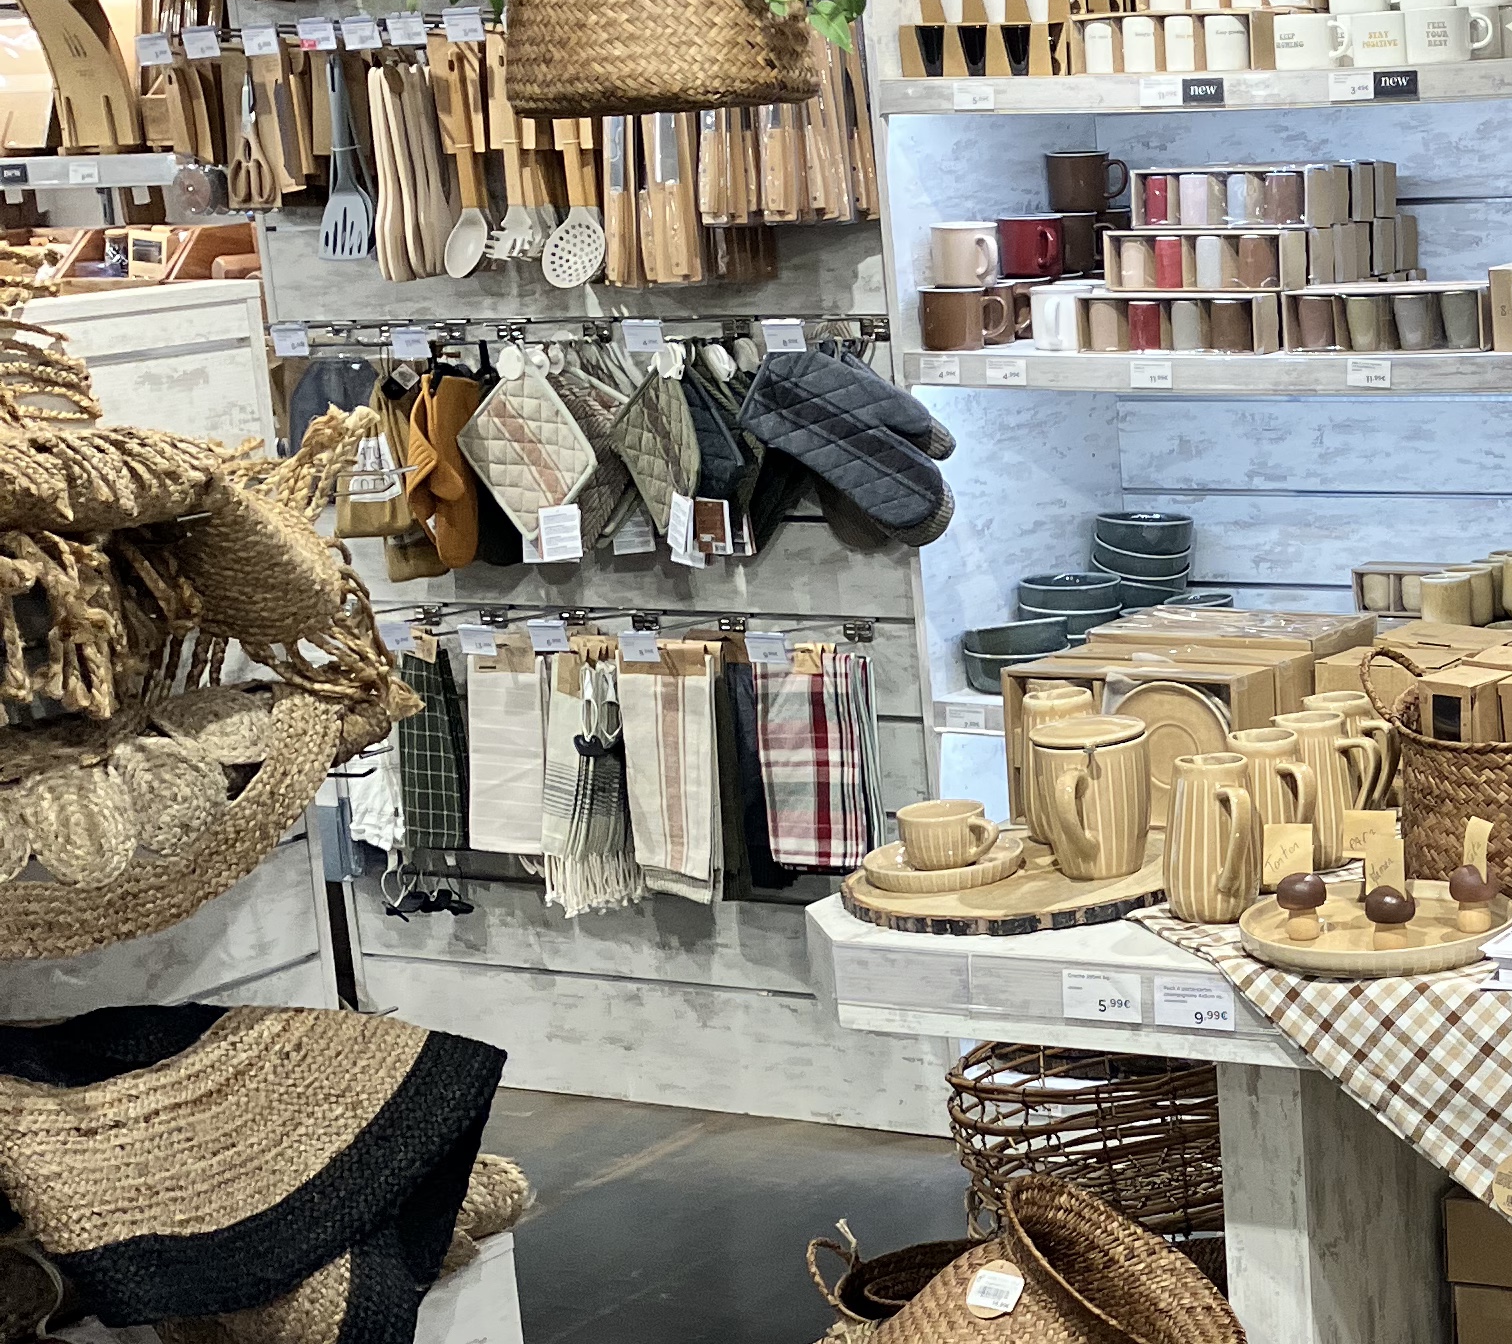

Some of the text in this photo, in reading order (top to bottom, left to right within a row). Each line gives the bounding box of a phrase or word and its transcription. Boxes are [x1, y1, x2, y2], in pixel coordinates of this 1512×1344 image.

[1427, 21, 1447, 30] FEEL
[1368, 30, 1390, 39] STAY
[1426, 30, 1449, 39] YOUR
[1427, 38, 1448, 47] BEST
[1381, 74, 1410, 87] new
[1189, 83, 1218, 96] new
